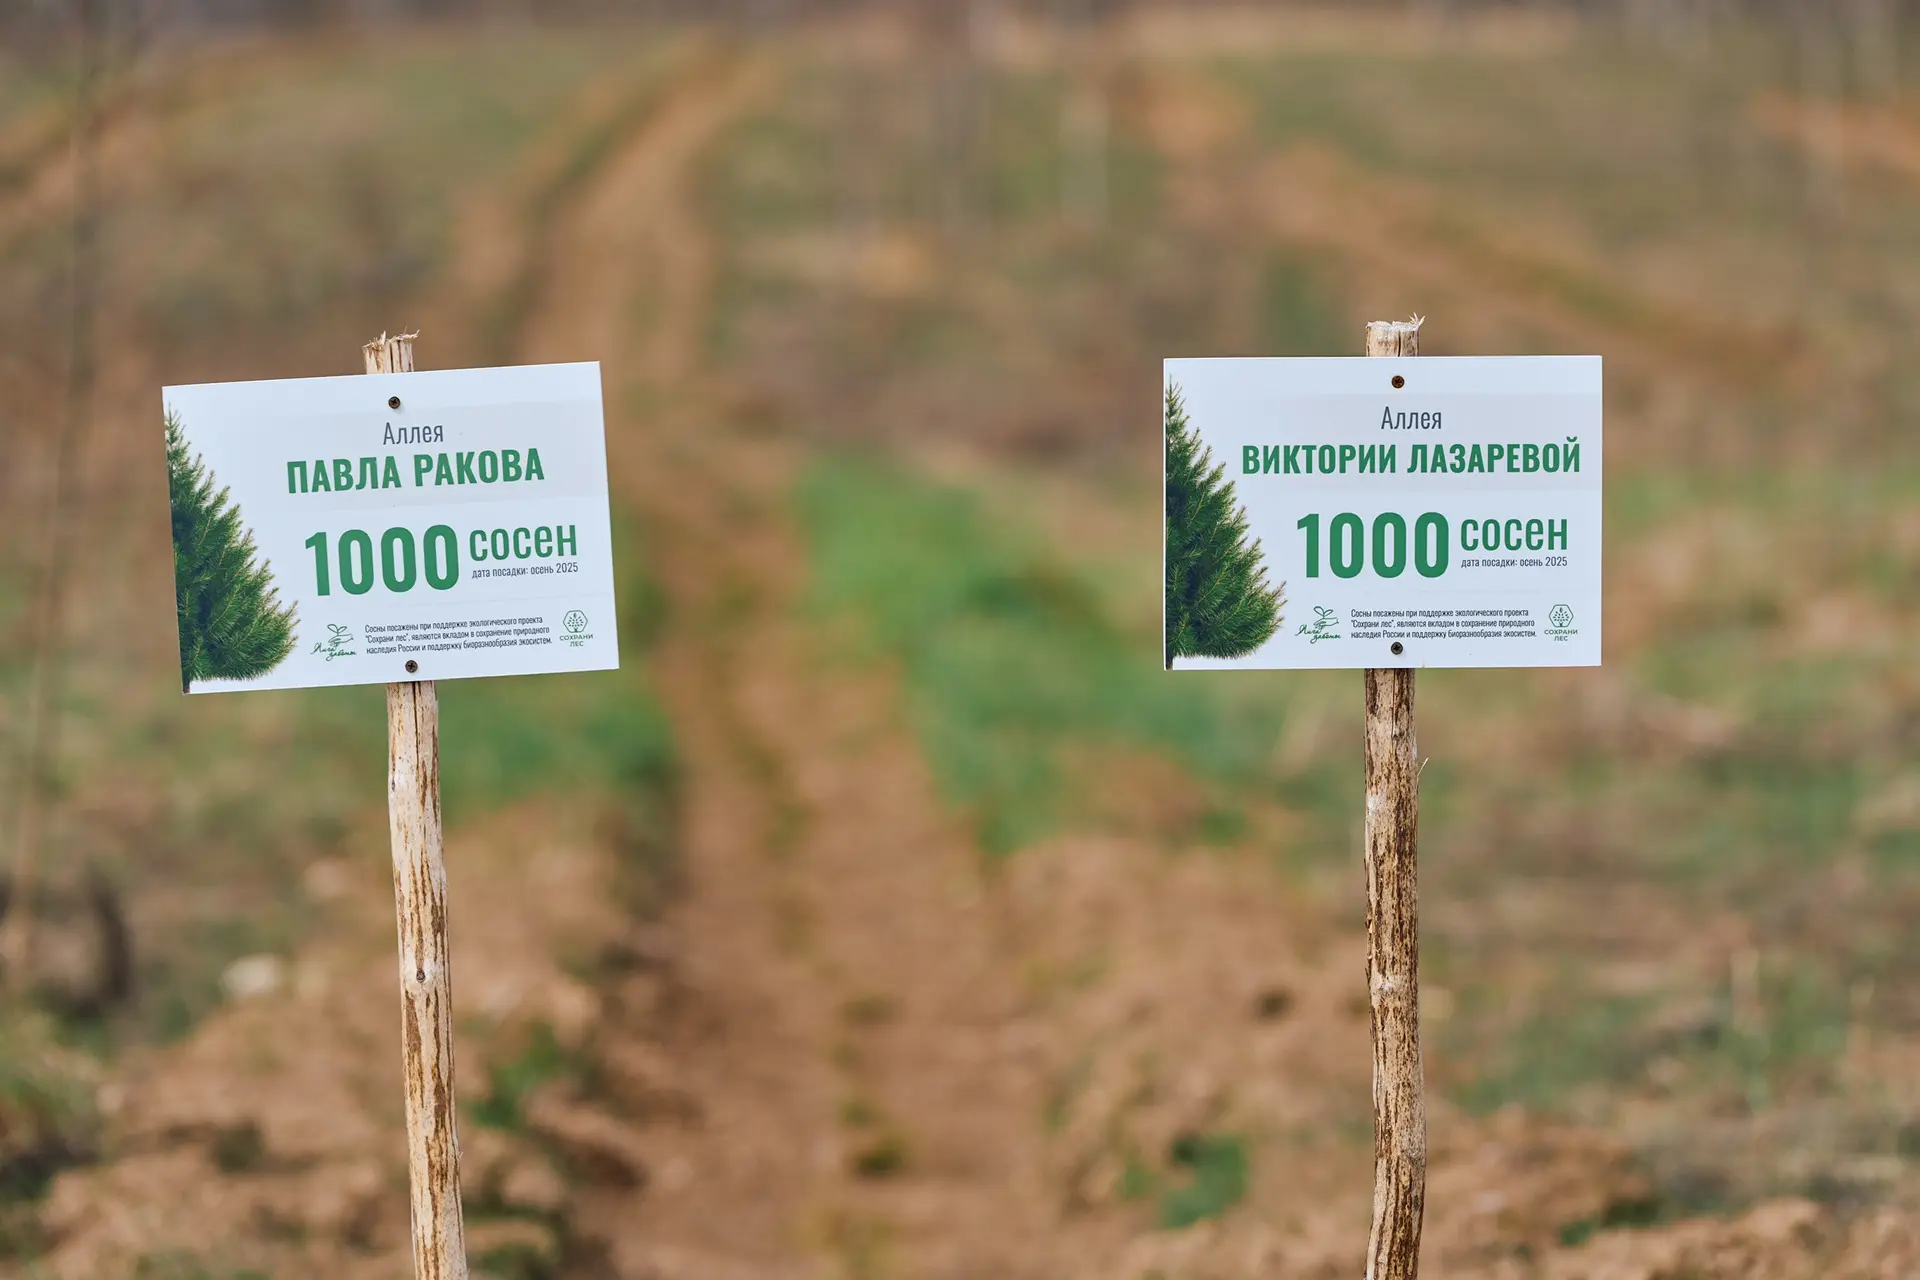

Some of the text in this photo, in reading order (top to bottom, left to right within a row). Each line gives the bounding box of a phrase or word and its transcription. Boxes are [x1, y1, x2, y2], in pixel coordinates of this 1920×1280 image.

[1381, 405, 1443, 430] Аллея
[383, 421, 444, 446] Аллея
[1242, 436, 1581, 475] ВИКТОРИИ ЛАЗАРЕВОЙ
[287, 447, 545, 494] ПАВЛА РАКОВА
[1297, 511, 1568, 579] 1000 сосен
[304, 524, 578, 597] 1000 сосен
[1460, 556, 1568, 569] дата посадки: осень 2025
[471, 561, 579, 579] дата посадки: осень 2025
[1350, 608, 1529, 619] Сосны посажены при поддержке экологического проекта
[364, 615, 543, 633] Сосны посажены при поддержке экологического проекта
[1396, 620, 1427, 628] являются
[1427, 620, 1455, 629] вкладом
[1460, 620, 1498, 629] сохранение
[1498, 620, 1535, 629] природного
[411, 631, 442, 642] являются
[442, 630, 469, 640] вкладом
[475, 627, 512, 639] сохранение
[512, 626, 550, 637] природного
[559, 634, 594, 642] СОХРАНИ
[1350, 630, 1381, 639] наследия
[1382, 629, 1406, 639] России
[1411, 630, 1447, 639] поддержку
[1447, 629, 1503, 640] биоразнообразия
[1503, 630, 1538, 638] экосистем.
[366, 645, 397, 655] наследия
[397, 643, 421, 653] России
[427, 641, 462, 653] поддержку
[462, 639, 518, 651] биоразнообразия
[518, 636, 553, 647] экосистем.
[569, 640, 584, 648] ЛЕС
